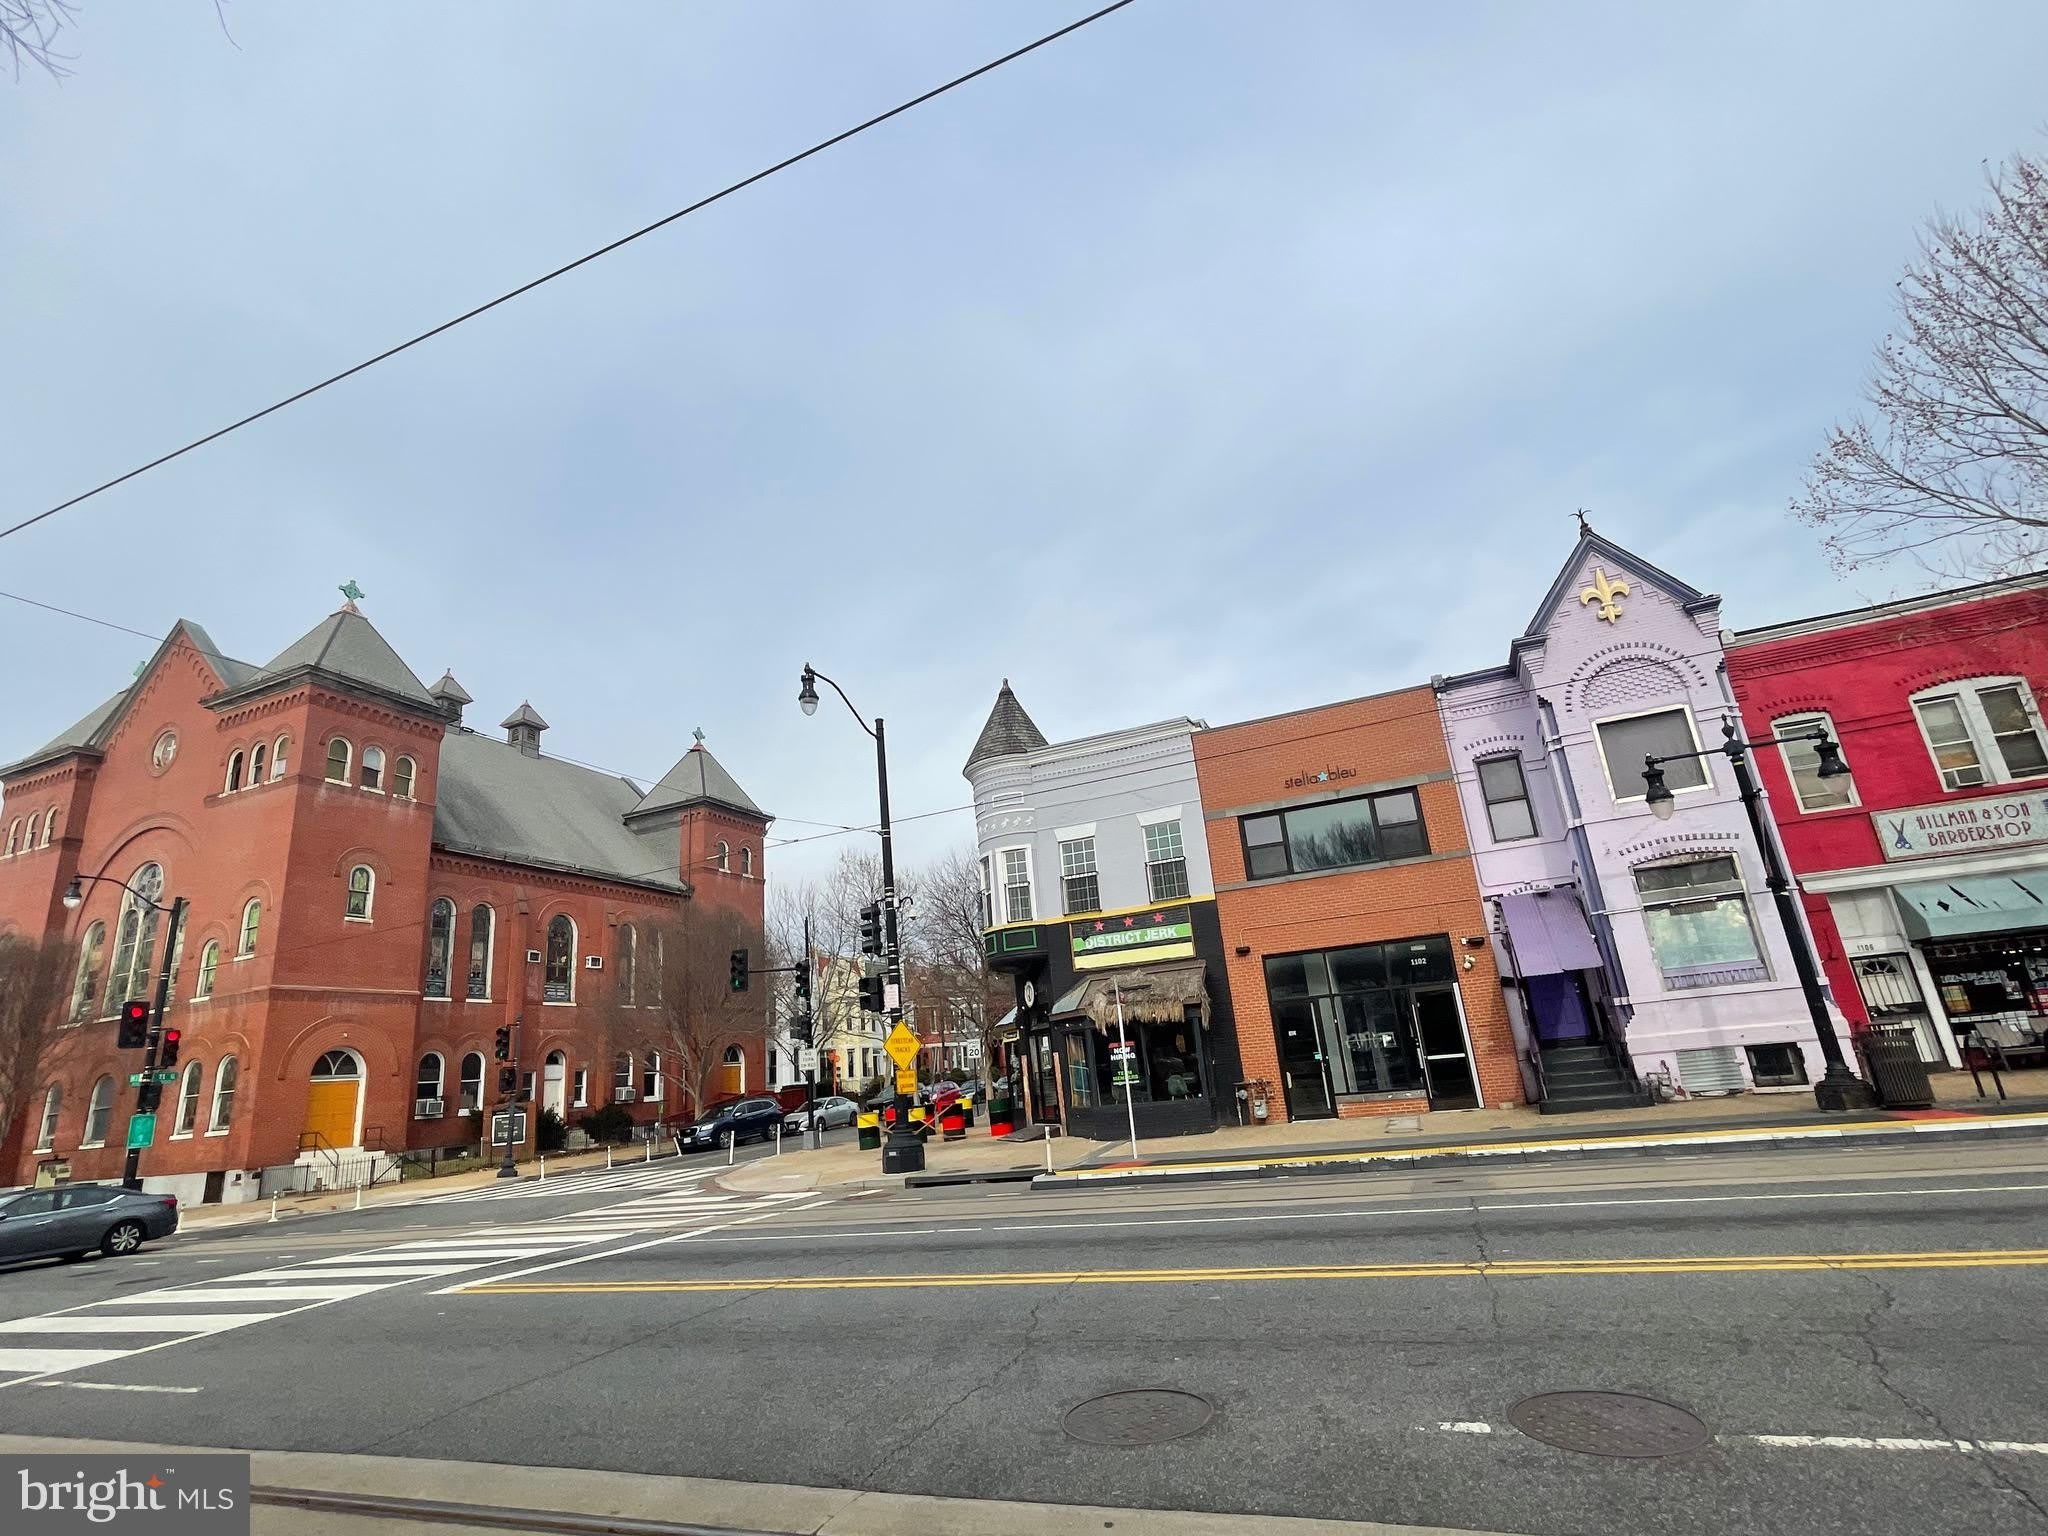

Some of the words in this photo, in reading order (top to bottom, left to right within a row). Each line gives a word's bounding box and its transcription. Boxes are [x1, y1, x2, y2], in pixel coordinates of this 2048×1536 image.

[1284, 770, 1318, 789] stella
[1326, 764, 1357, 781] bleu
[1916, 808, 1978, 830] HILLMAN
[1982, 808, 1991, 820] &
[1993, 802, 2032, 820] SON
[1927, 821, 2032, 847] BARBERSHOP
[1085, 932, 1140, 949] DISTRICT
[1144, 926, 1177, 941] JERK
[1410, 958, 1427, 966] 1102
[969, 1048, 980, 1056] 20
[1110, 1053, 1136, 1061] HIRNG
